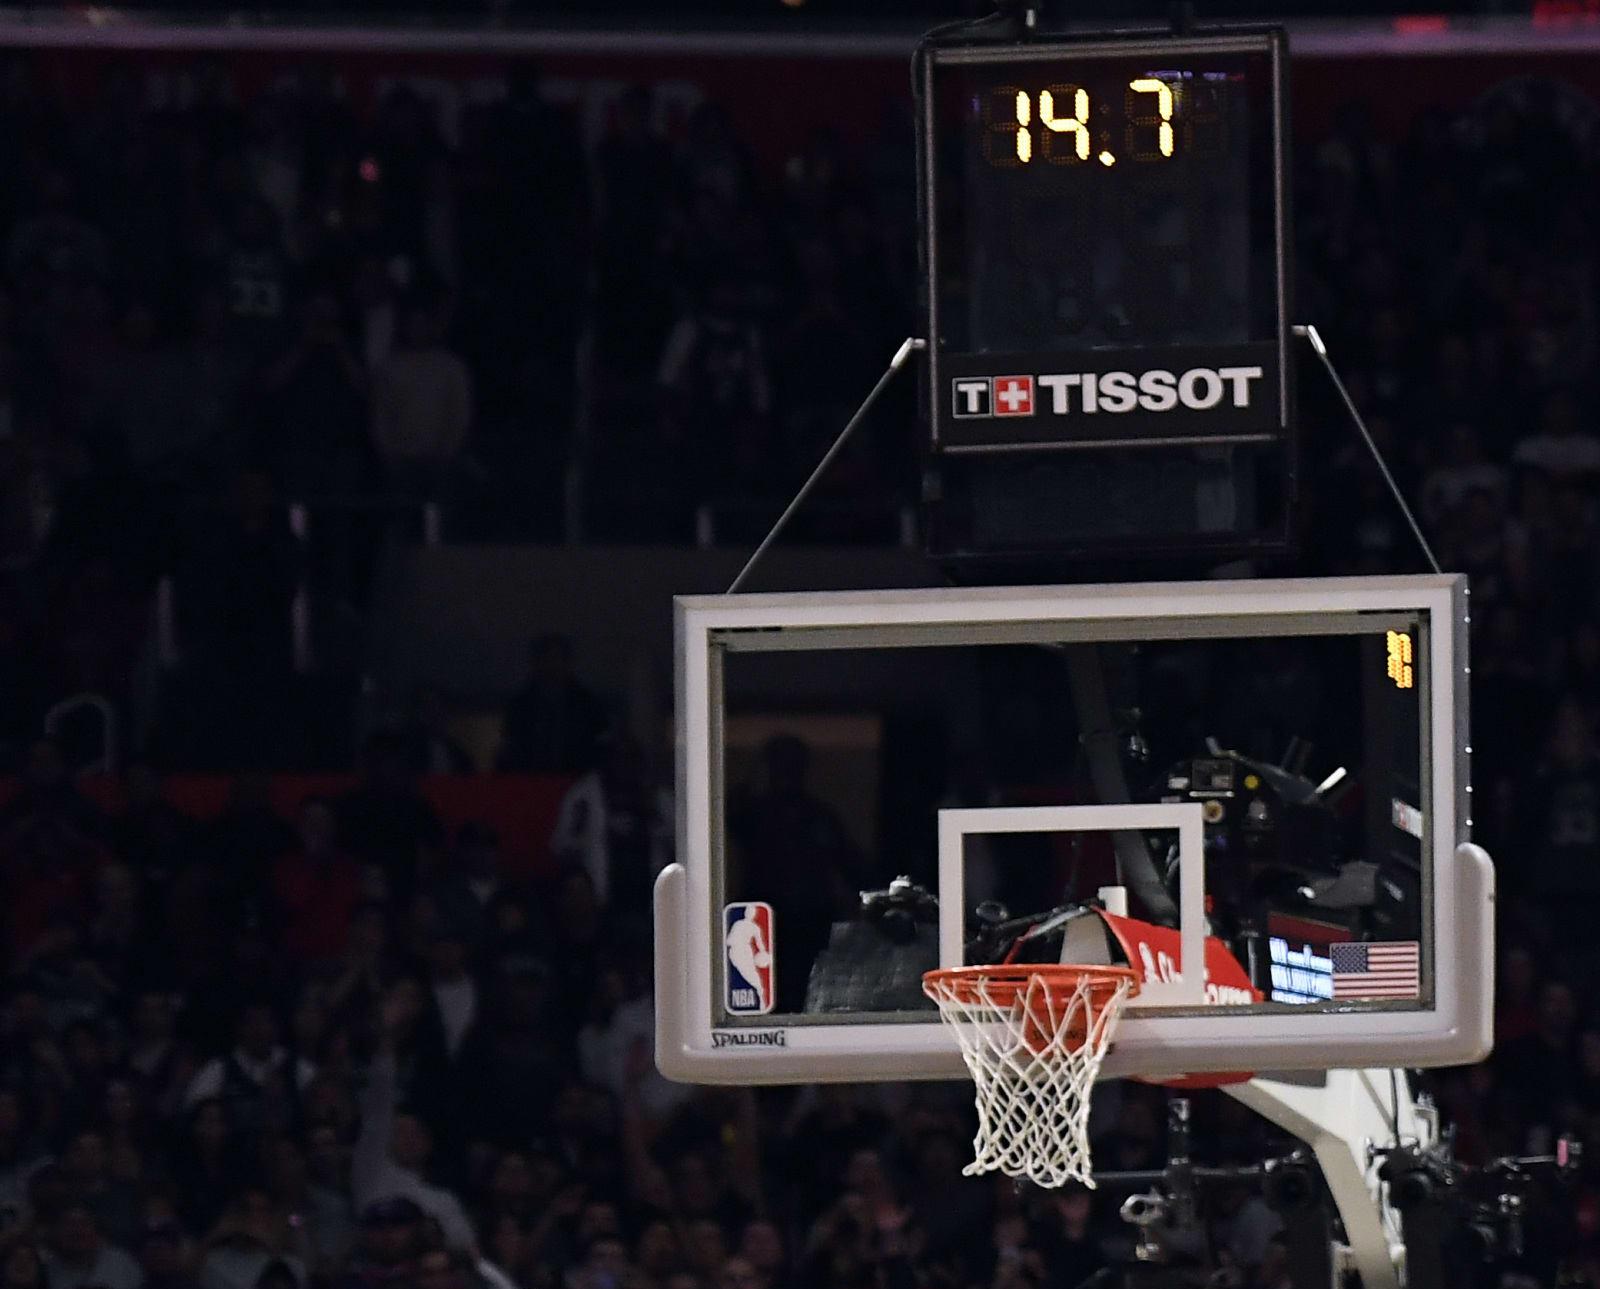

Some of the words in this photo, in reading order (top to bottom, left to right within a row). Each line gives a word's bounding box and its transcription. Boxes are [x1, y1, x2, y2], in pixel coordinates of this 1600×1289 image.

[1016, 79, 1174, 167] 14.7
[1038, 366, 1263, 415] TISSOT
[732, 988, 756, 1008] NBA
[711, 1030, 785, 1048] SPALDING
